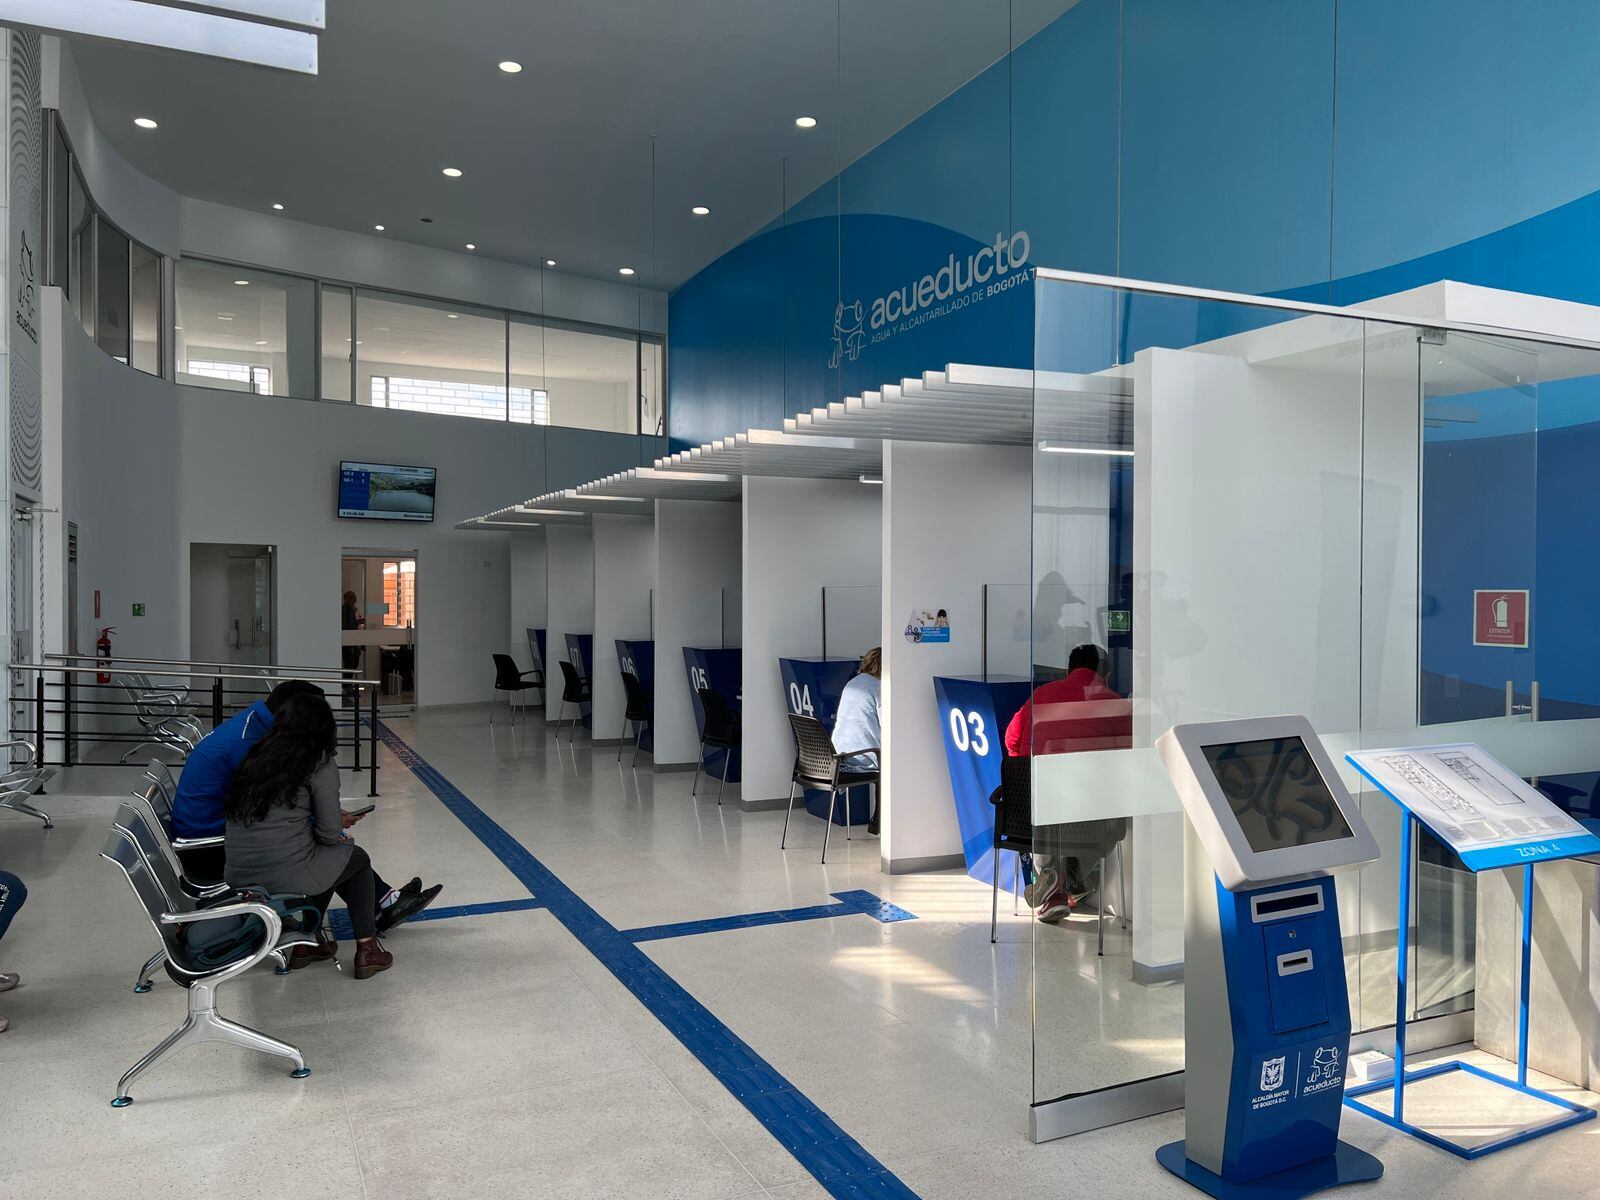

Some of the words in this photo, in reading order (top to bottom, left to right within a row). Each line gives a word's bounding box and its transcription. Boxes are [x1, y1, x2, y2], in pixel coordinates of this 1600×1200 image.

[870, 230, 1031, 329] acueducto
[871, 329, 891, 345] AGUA
[891, 325, 898, 336] Y
[899, 295, 970, 332] ALCANTARILLADO
[972, 291, 984, 304] DE
[987, 269, 1029, 297] BOGOTÁ
[691, 666, 709, 693] 05
[789, 682, 815, 717] 04
[950, 707, 990, 757] 03
[1514, 845, 1552, 857] ZONA
[1551, 843, 1561, 852] 4
[1273, 1089, 1290, 1098] MAYOR
[1303, 1076, 1342, 1093] acueducto
